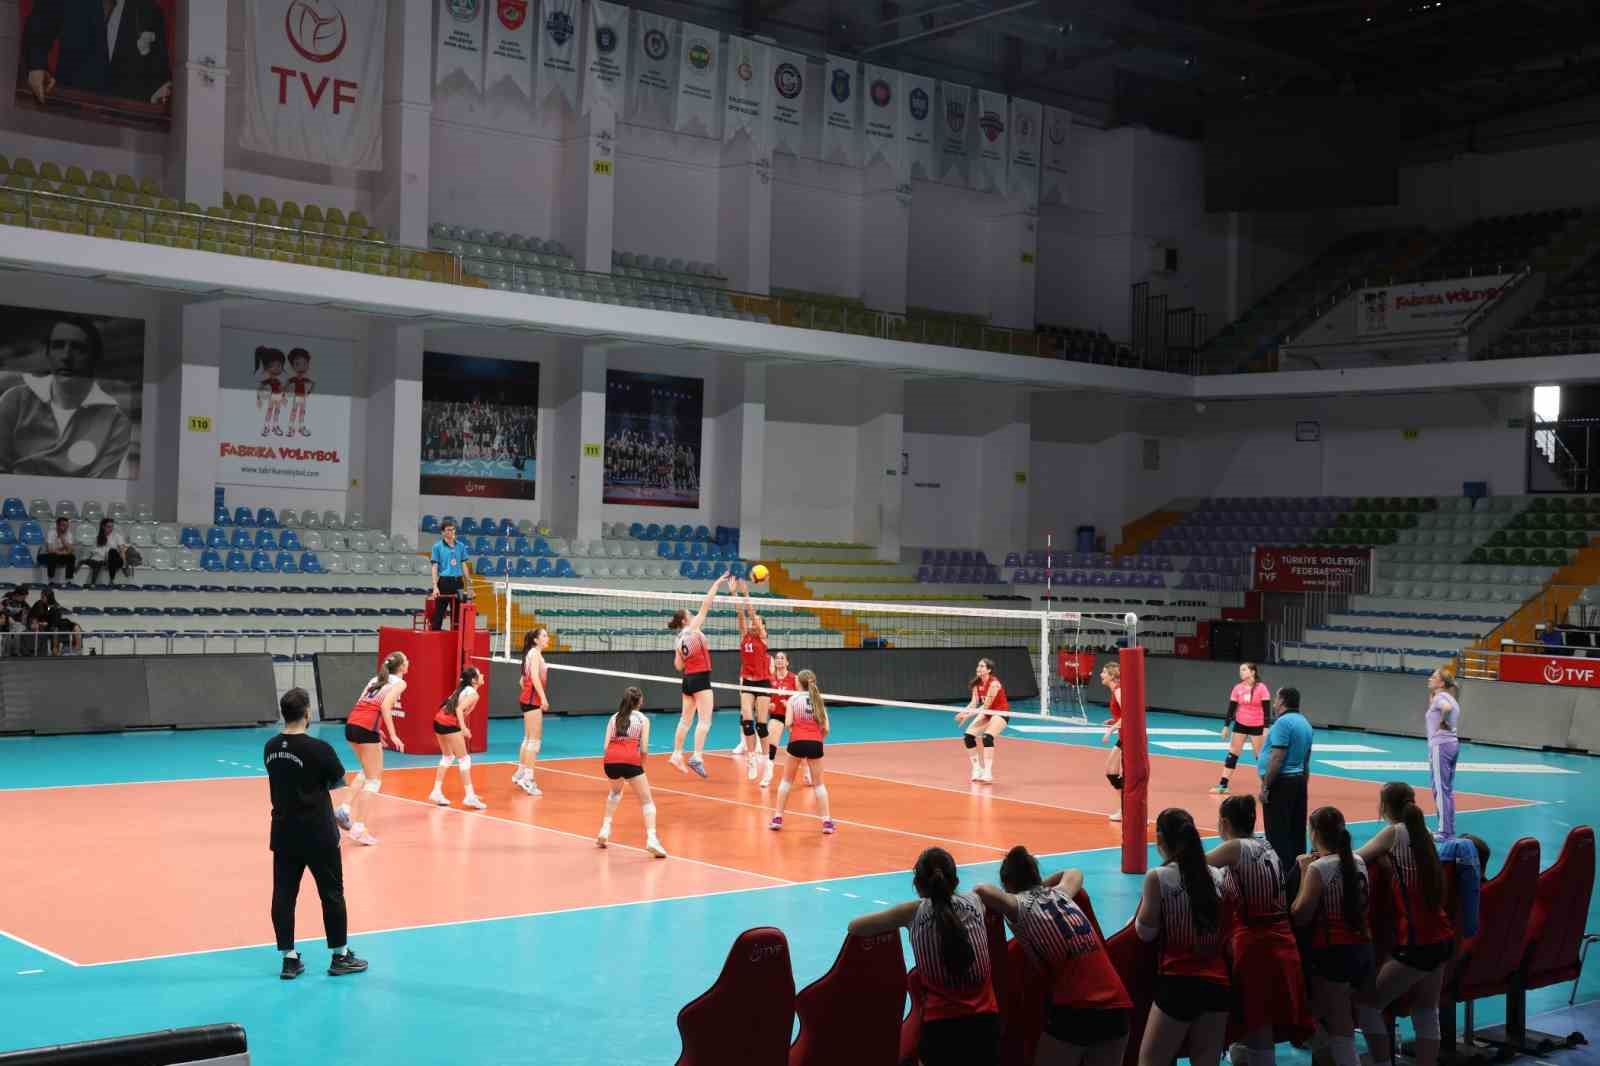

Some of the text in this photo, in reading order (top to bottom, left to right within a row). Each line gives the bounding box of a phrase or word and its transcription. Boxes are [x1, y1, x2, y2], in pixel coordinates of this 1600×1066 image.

[271, 65, 358, 114] TVF
[191, 419, 209, 430] 110
[278, 446, 341, 463] VOLEYBOL
[586, 446, 600, 456] 111
[1258, 571, 1278, 583] TVF
[681, 640, 690, 657] 6
[744, 642, 754, 653] 11
[1565, 668, 1595, 682] TVF
[1039, 897, 1093, 940] 15
